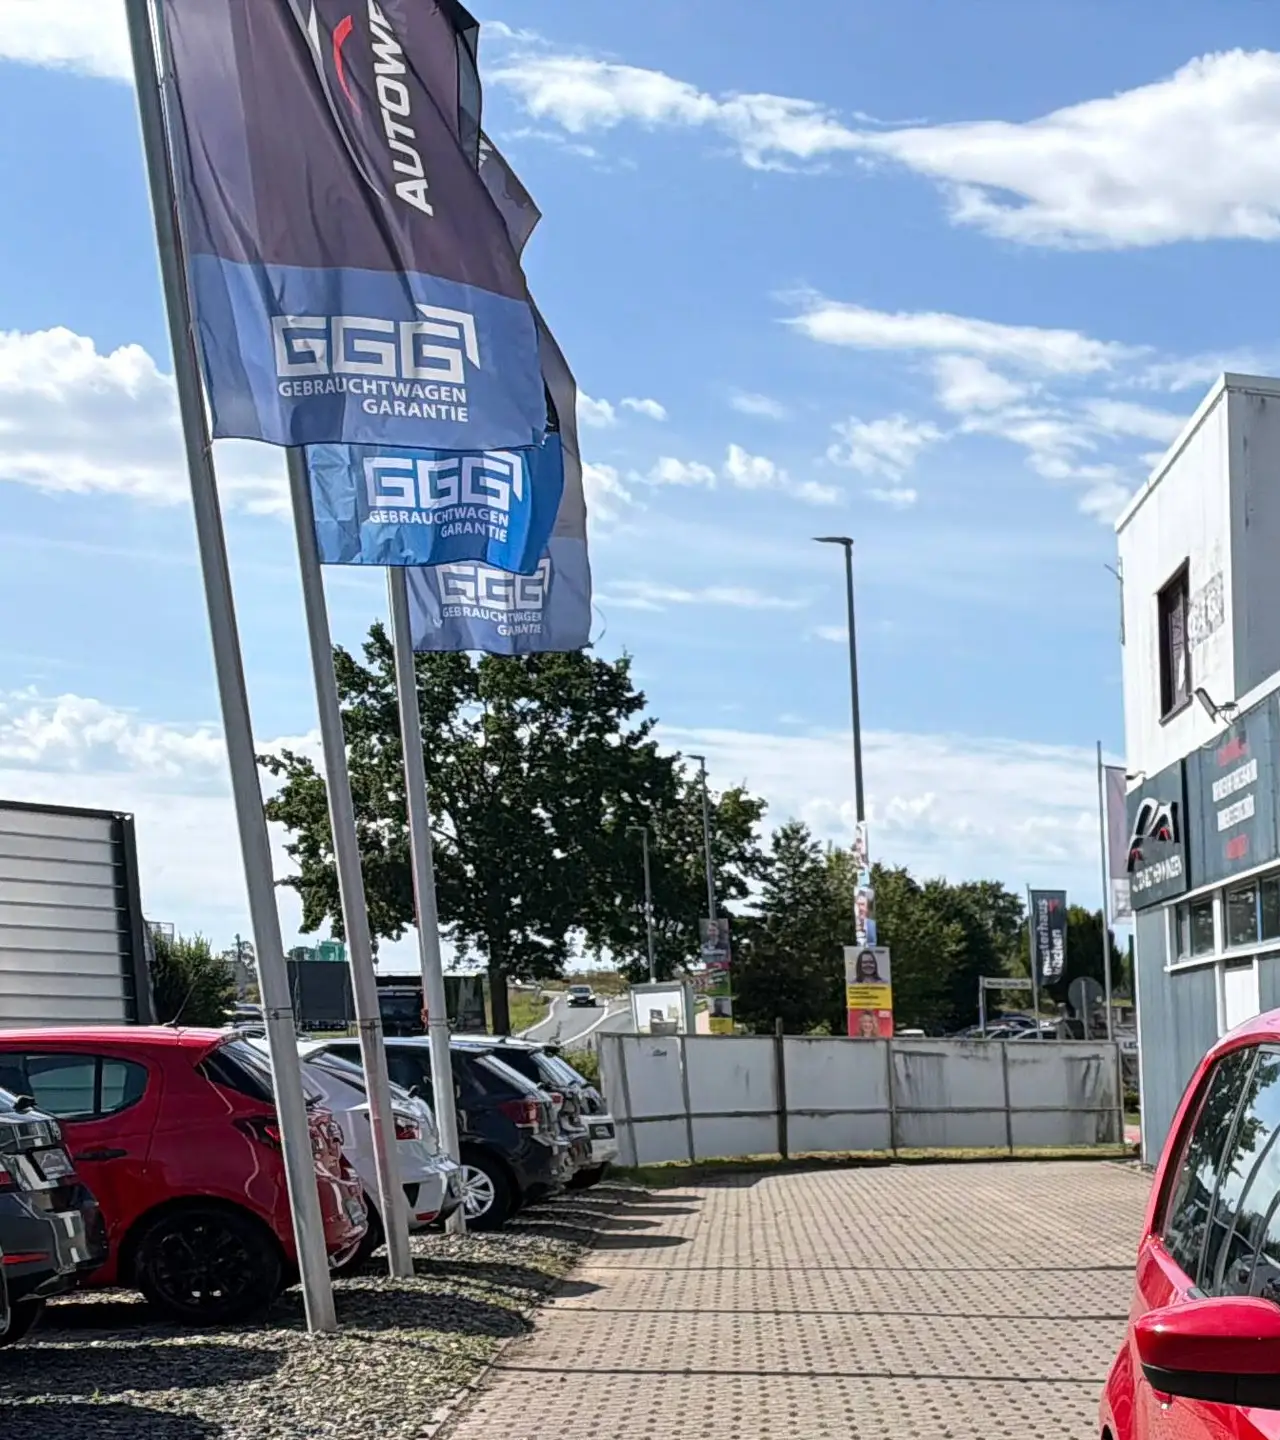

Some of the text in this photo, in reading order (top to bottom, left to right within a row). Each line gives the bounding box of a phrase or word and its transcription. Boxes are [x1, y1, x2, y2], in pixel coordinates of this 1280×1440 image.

[271, 304, 474, 385] GGG
[278, 376, 467, 404] GEBRAUCHTWAGEN
[362, 399, 469, 423] GARANTIE
[363, 453, 516, 511] GGG
[369, 506, 509, 527] GEBRAUCHTWAGEN
[440, 522, 508, 543] GARANTIE
